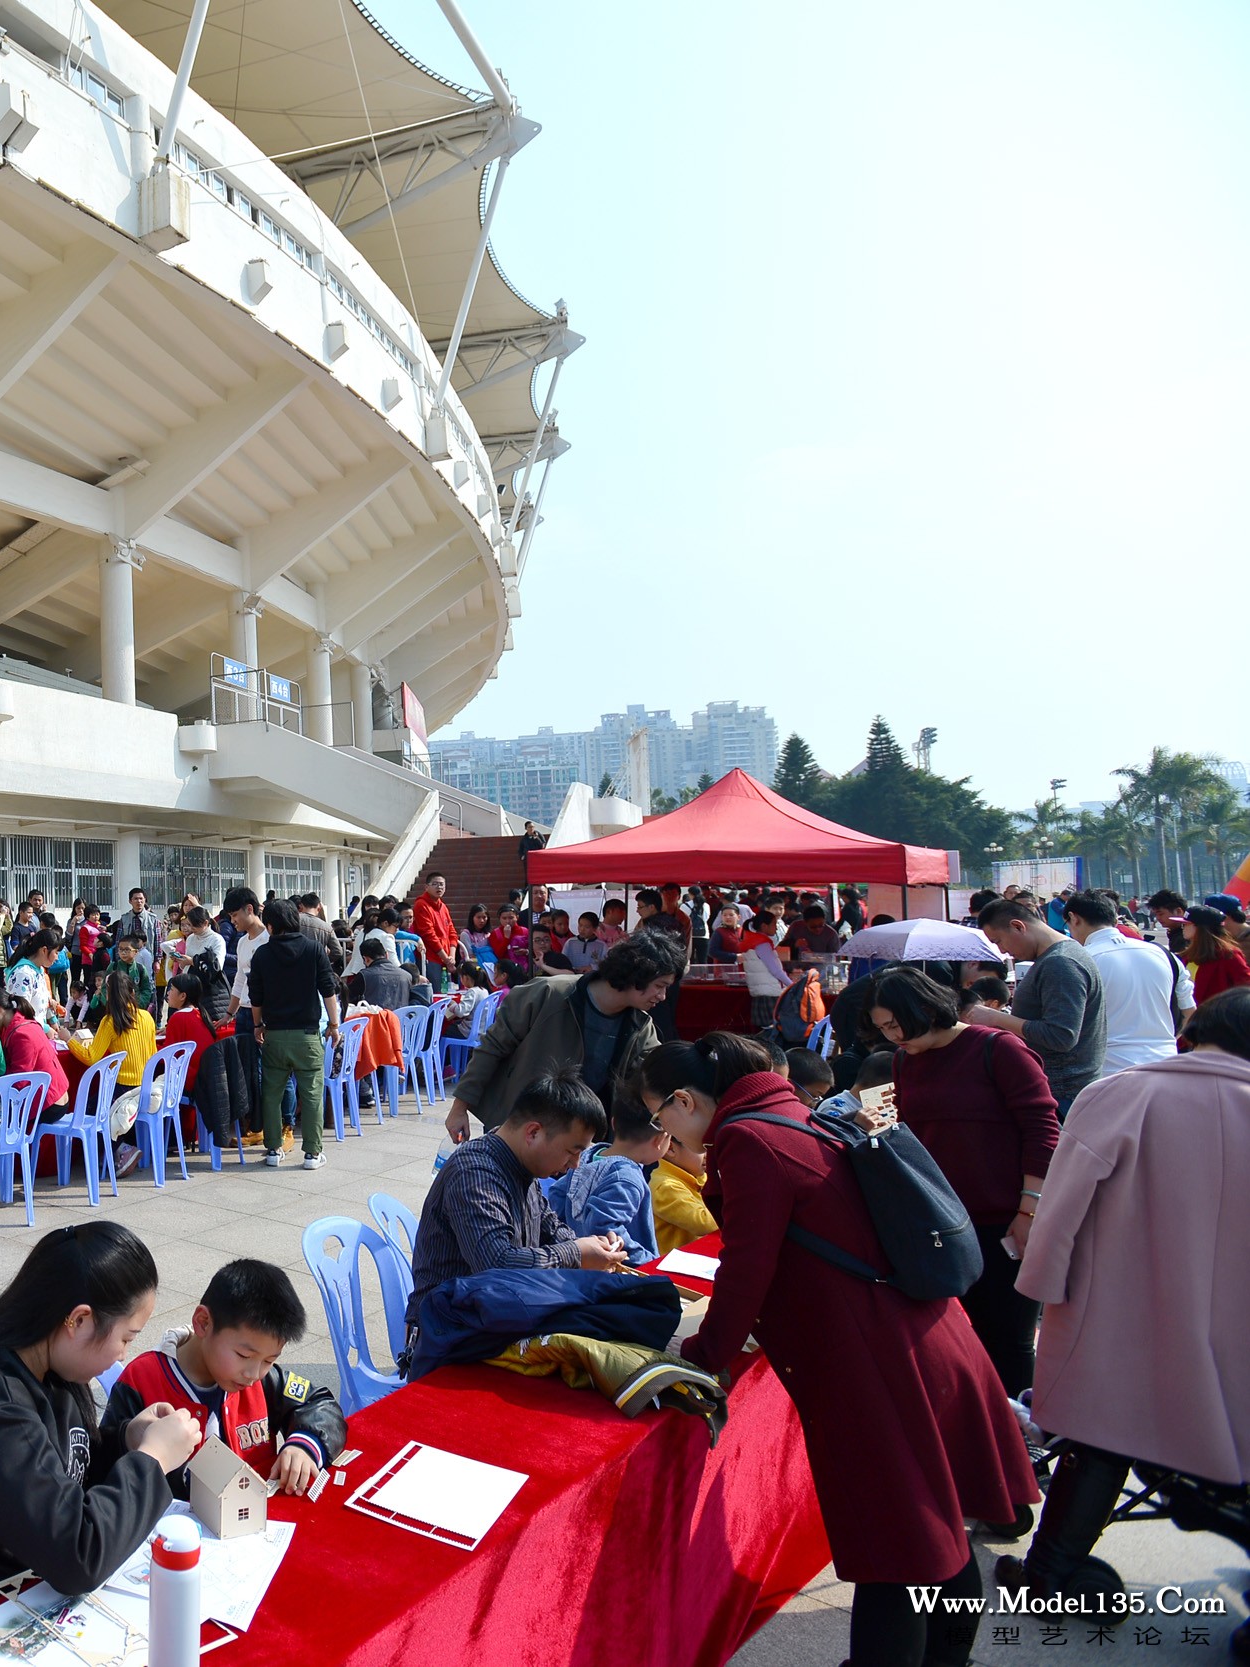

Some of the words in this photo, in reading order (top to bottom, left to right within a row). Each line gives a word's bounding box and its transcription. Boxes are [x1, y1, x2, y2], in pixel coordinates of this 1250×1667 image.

[225, 663, 245, 684] 西3台
[271, 680, 289, 698] 西4台
[236, 1417, 269, 1450] BOY
